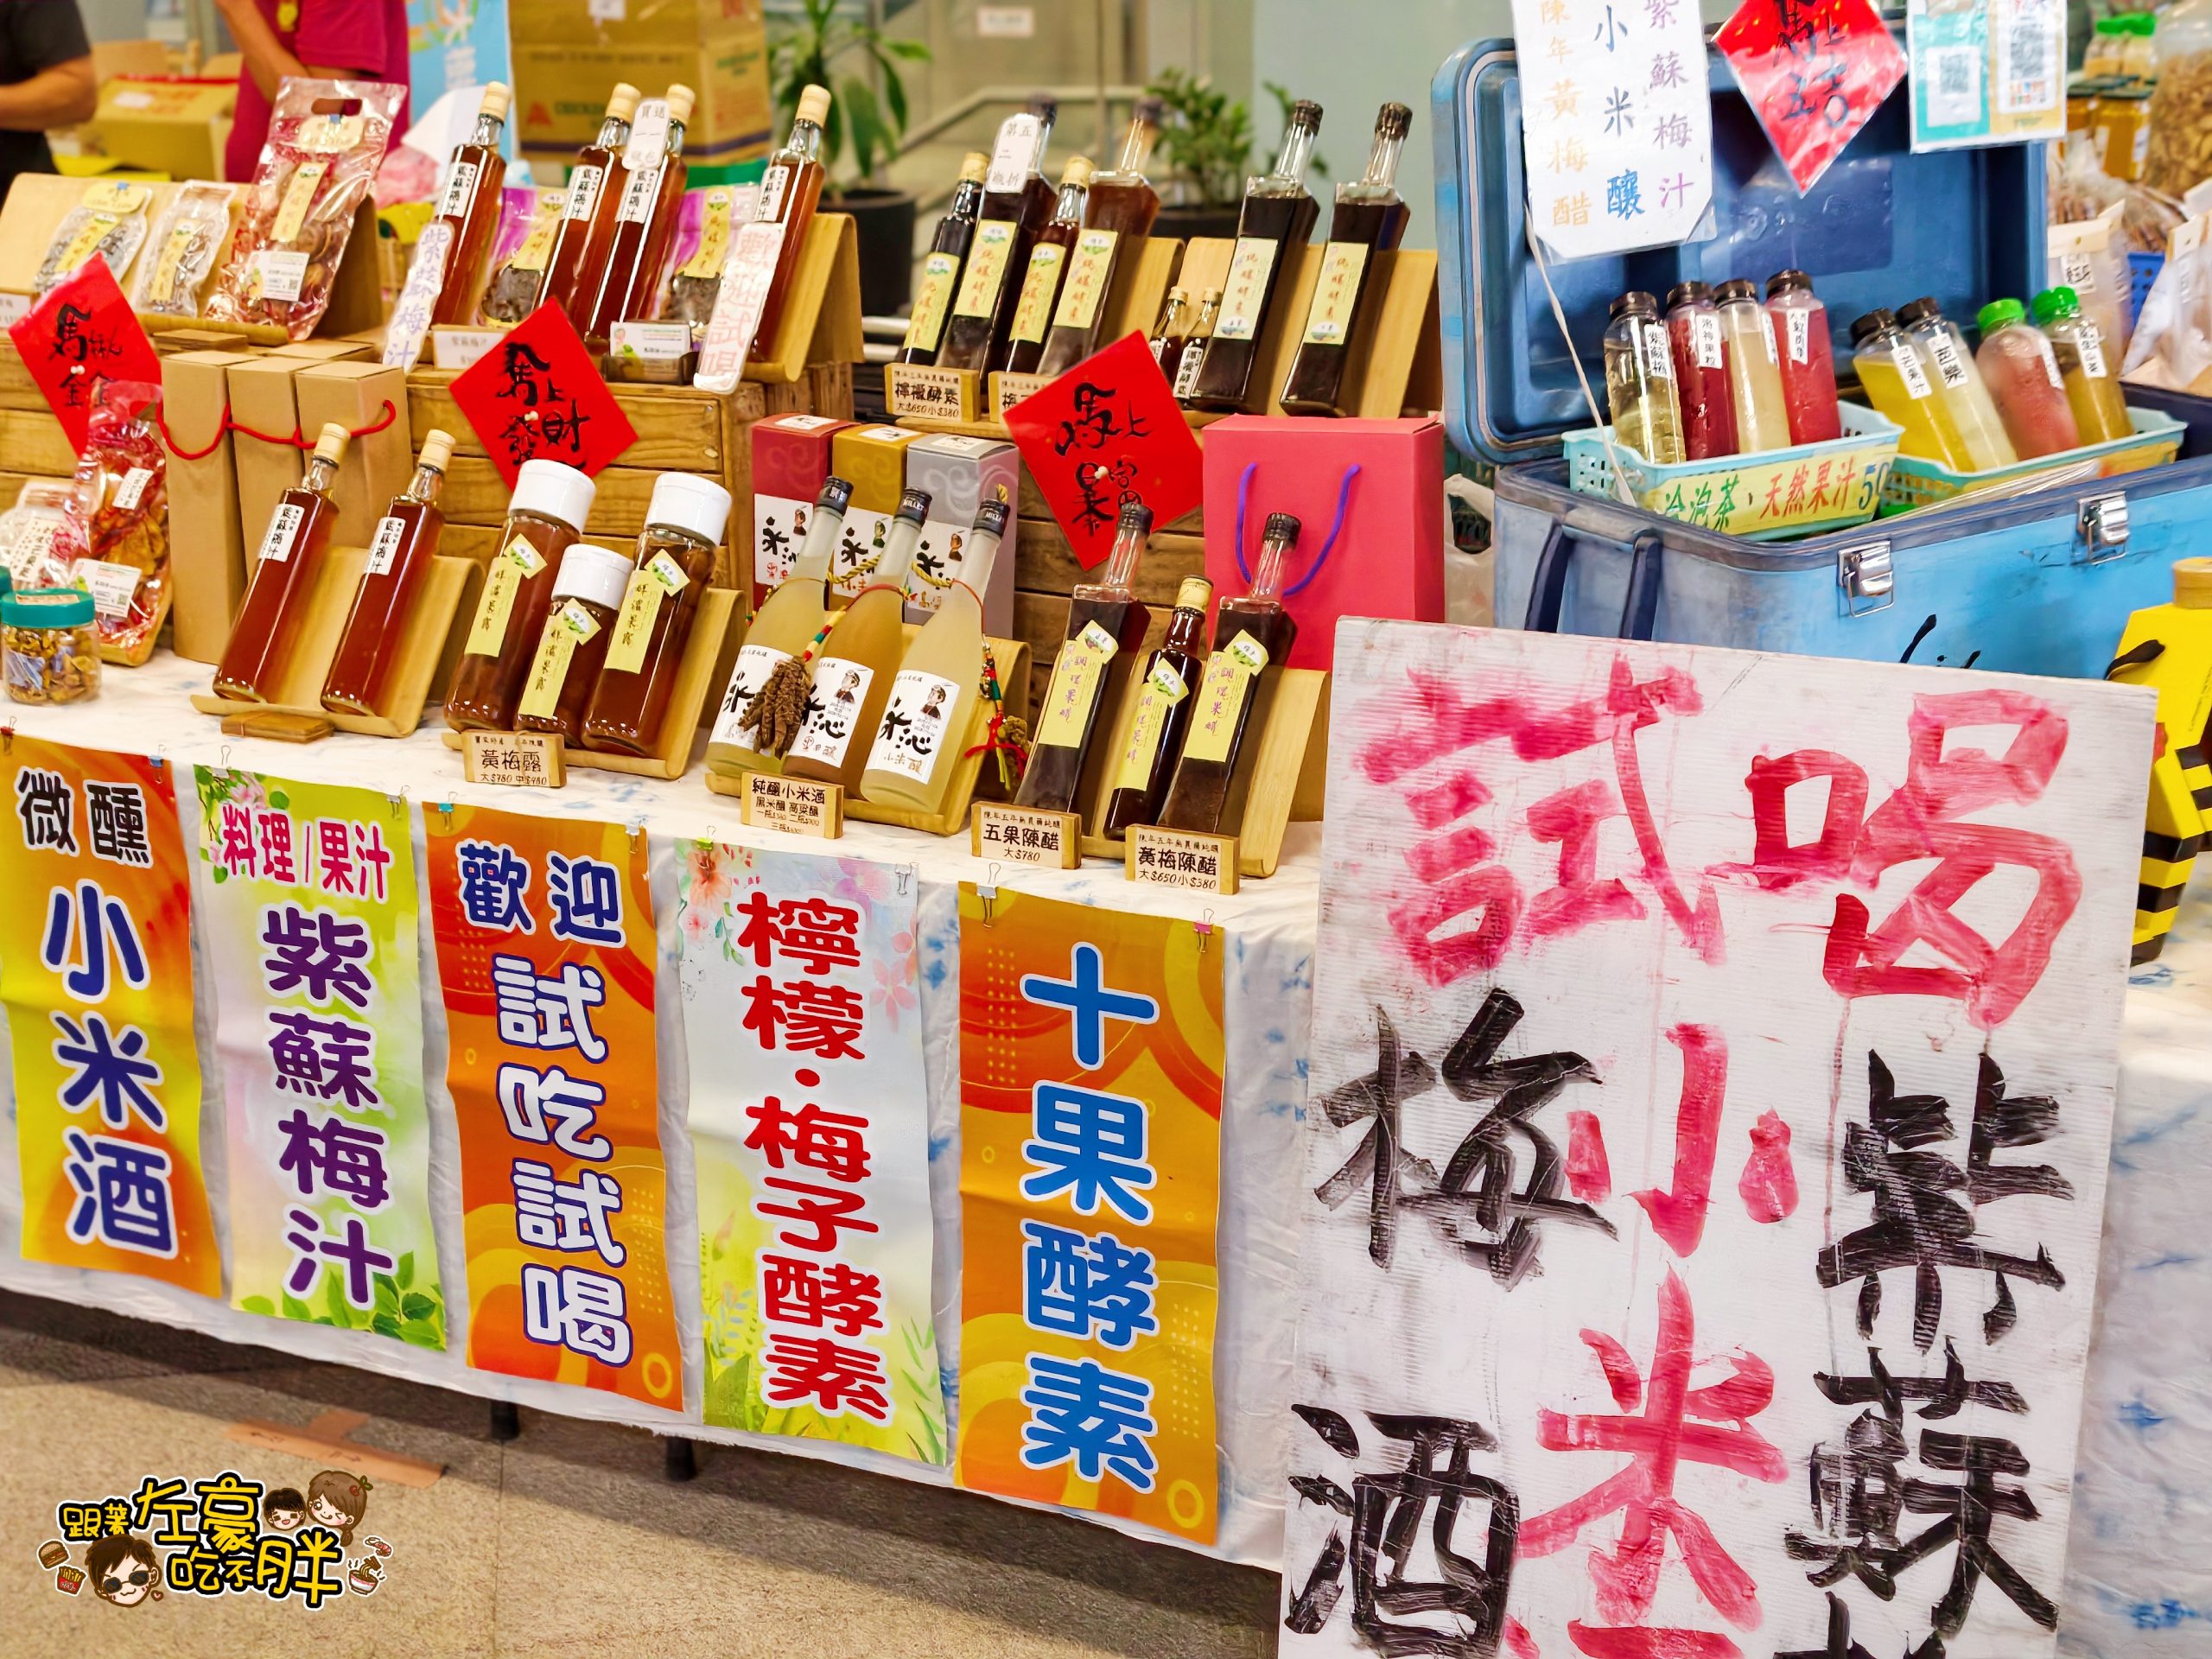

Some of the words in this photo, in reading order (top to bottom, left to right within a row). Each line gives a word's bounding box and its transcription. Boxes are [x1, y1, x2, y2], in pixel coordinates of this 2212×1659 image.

[1594, 4, 1645, 220] 小米釀
[1643, 0, 1694, 208] 紫蘇梅汁
[895, 382, 959, 405] 檸檬酵素
[17, 770, 149, 864] 微醺
[481, 749, 542, 772] 黃梅露
[983, 823, 1059, 850] 五果陳醋
[1004, 847, 1039, 861] 大$780
[1139, 846, 1217, 875] 黃梅陳醋
[1355, 654, 2081, 1029] 試喝
[459, 843, 622, 944] 歡迎
[46, 885, 173, 1251] 小米酒
[263, 907, 393, 1304] 紫蘇梅汁
[493, 955, 632, 1367] 試吃試喝
[1021, 946, 1155, 1491] 十果酵素
[1286, 988, 1619, 1659] 梅酒
[1505, 1023, 1801, 1659] 小米
[1774, 1050, 2073, 1659] 紫蘇
